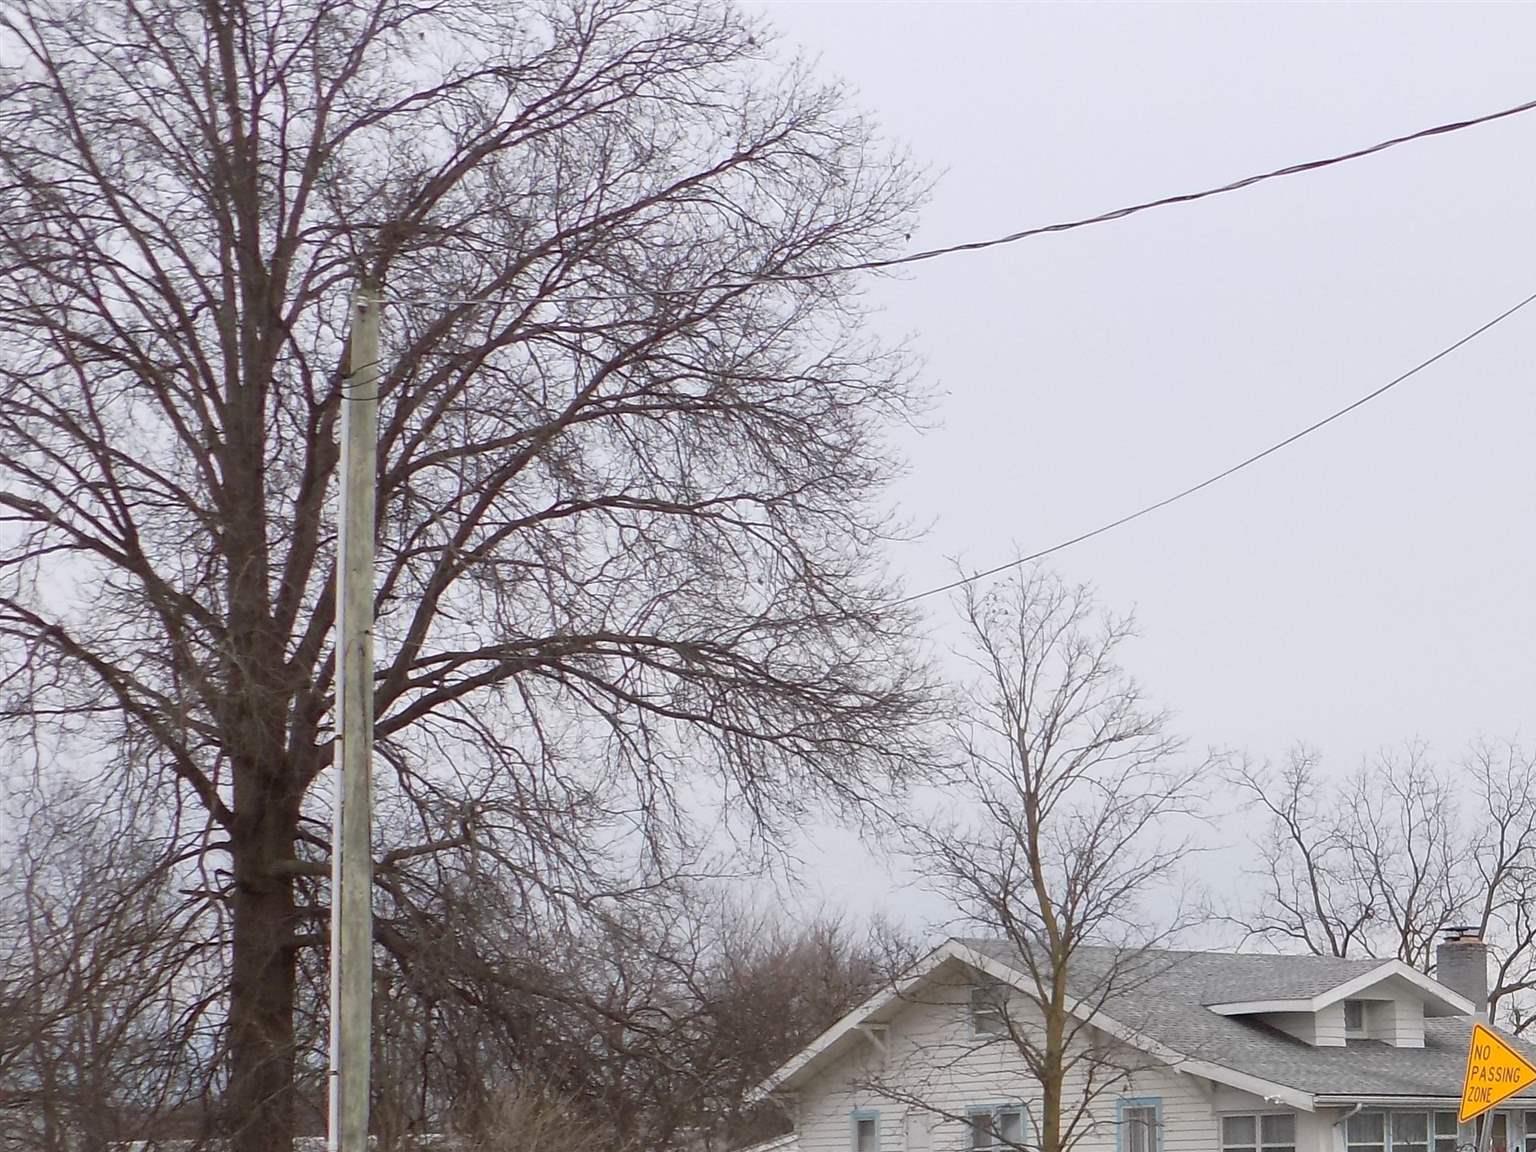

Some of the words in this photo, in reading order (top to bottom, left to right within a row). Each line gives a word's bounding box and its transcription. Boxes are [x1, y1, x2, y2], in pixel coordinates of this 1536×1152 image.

[1474, 1045, 1491, 1060] NO
[1471, 1066, 1520, 1083] PASSING
[1467, 1086, 1493, 1103] ZONE
